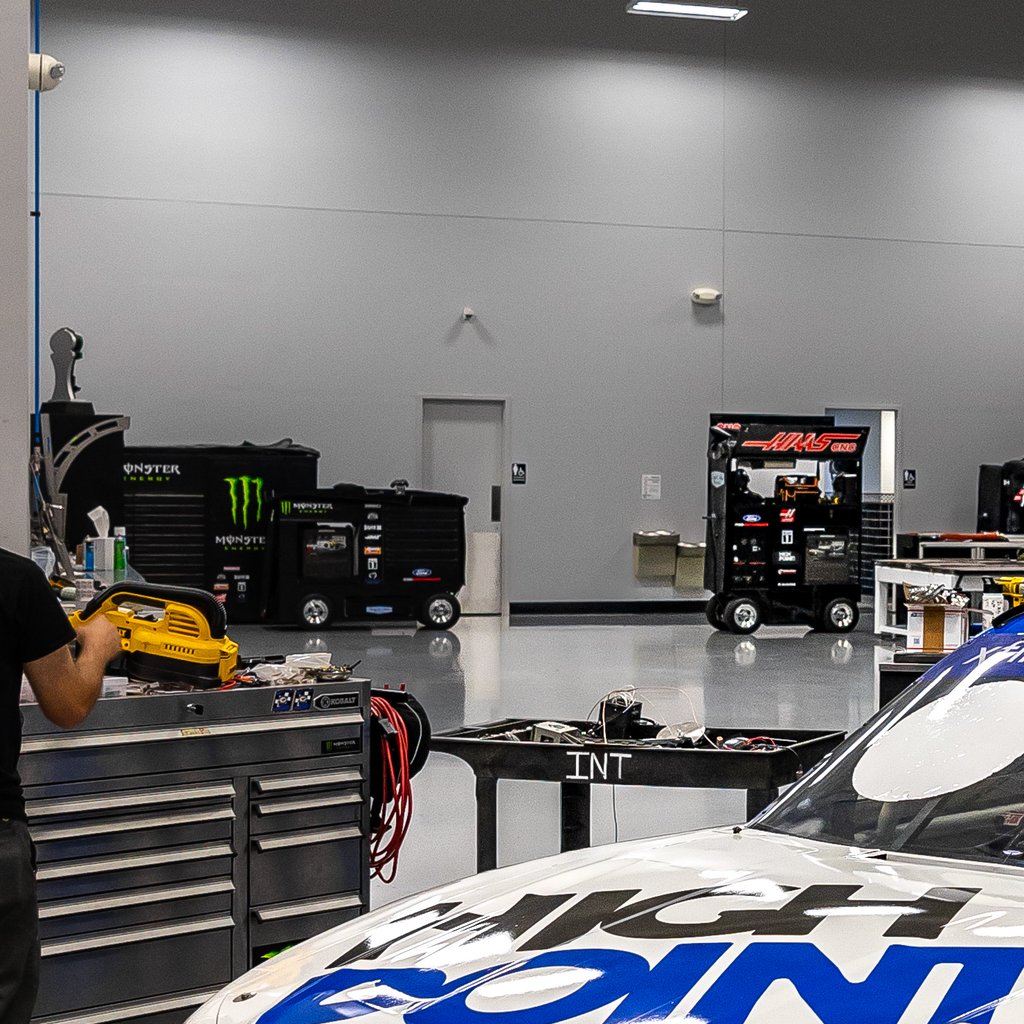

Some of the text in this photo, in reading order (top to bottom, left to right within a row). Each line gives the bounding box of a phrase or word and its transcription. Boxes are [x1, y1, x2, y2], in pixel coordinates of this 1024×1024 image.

[741, 432, 862, 452] HAAS
[123, 463, 181, 475] ONSTER
[215, 535, 266, 545] MONSTE
[566, 752, 632, 780] INT
